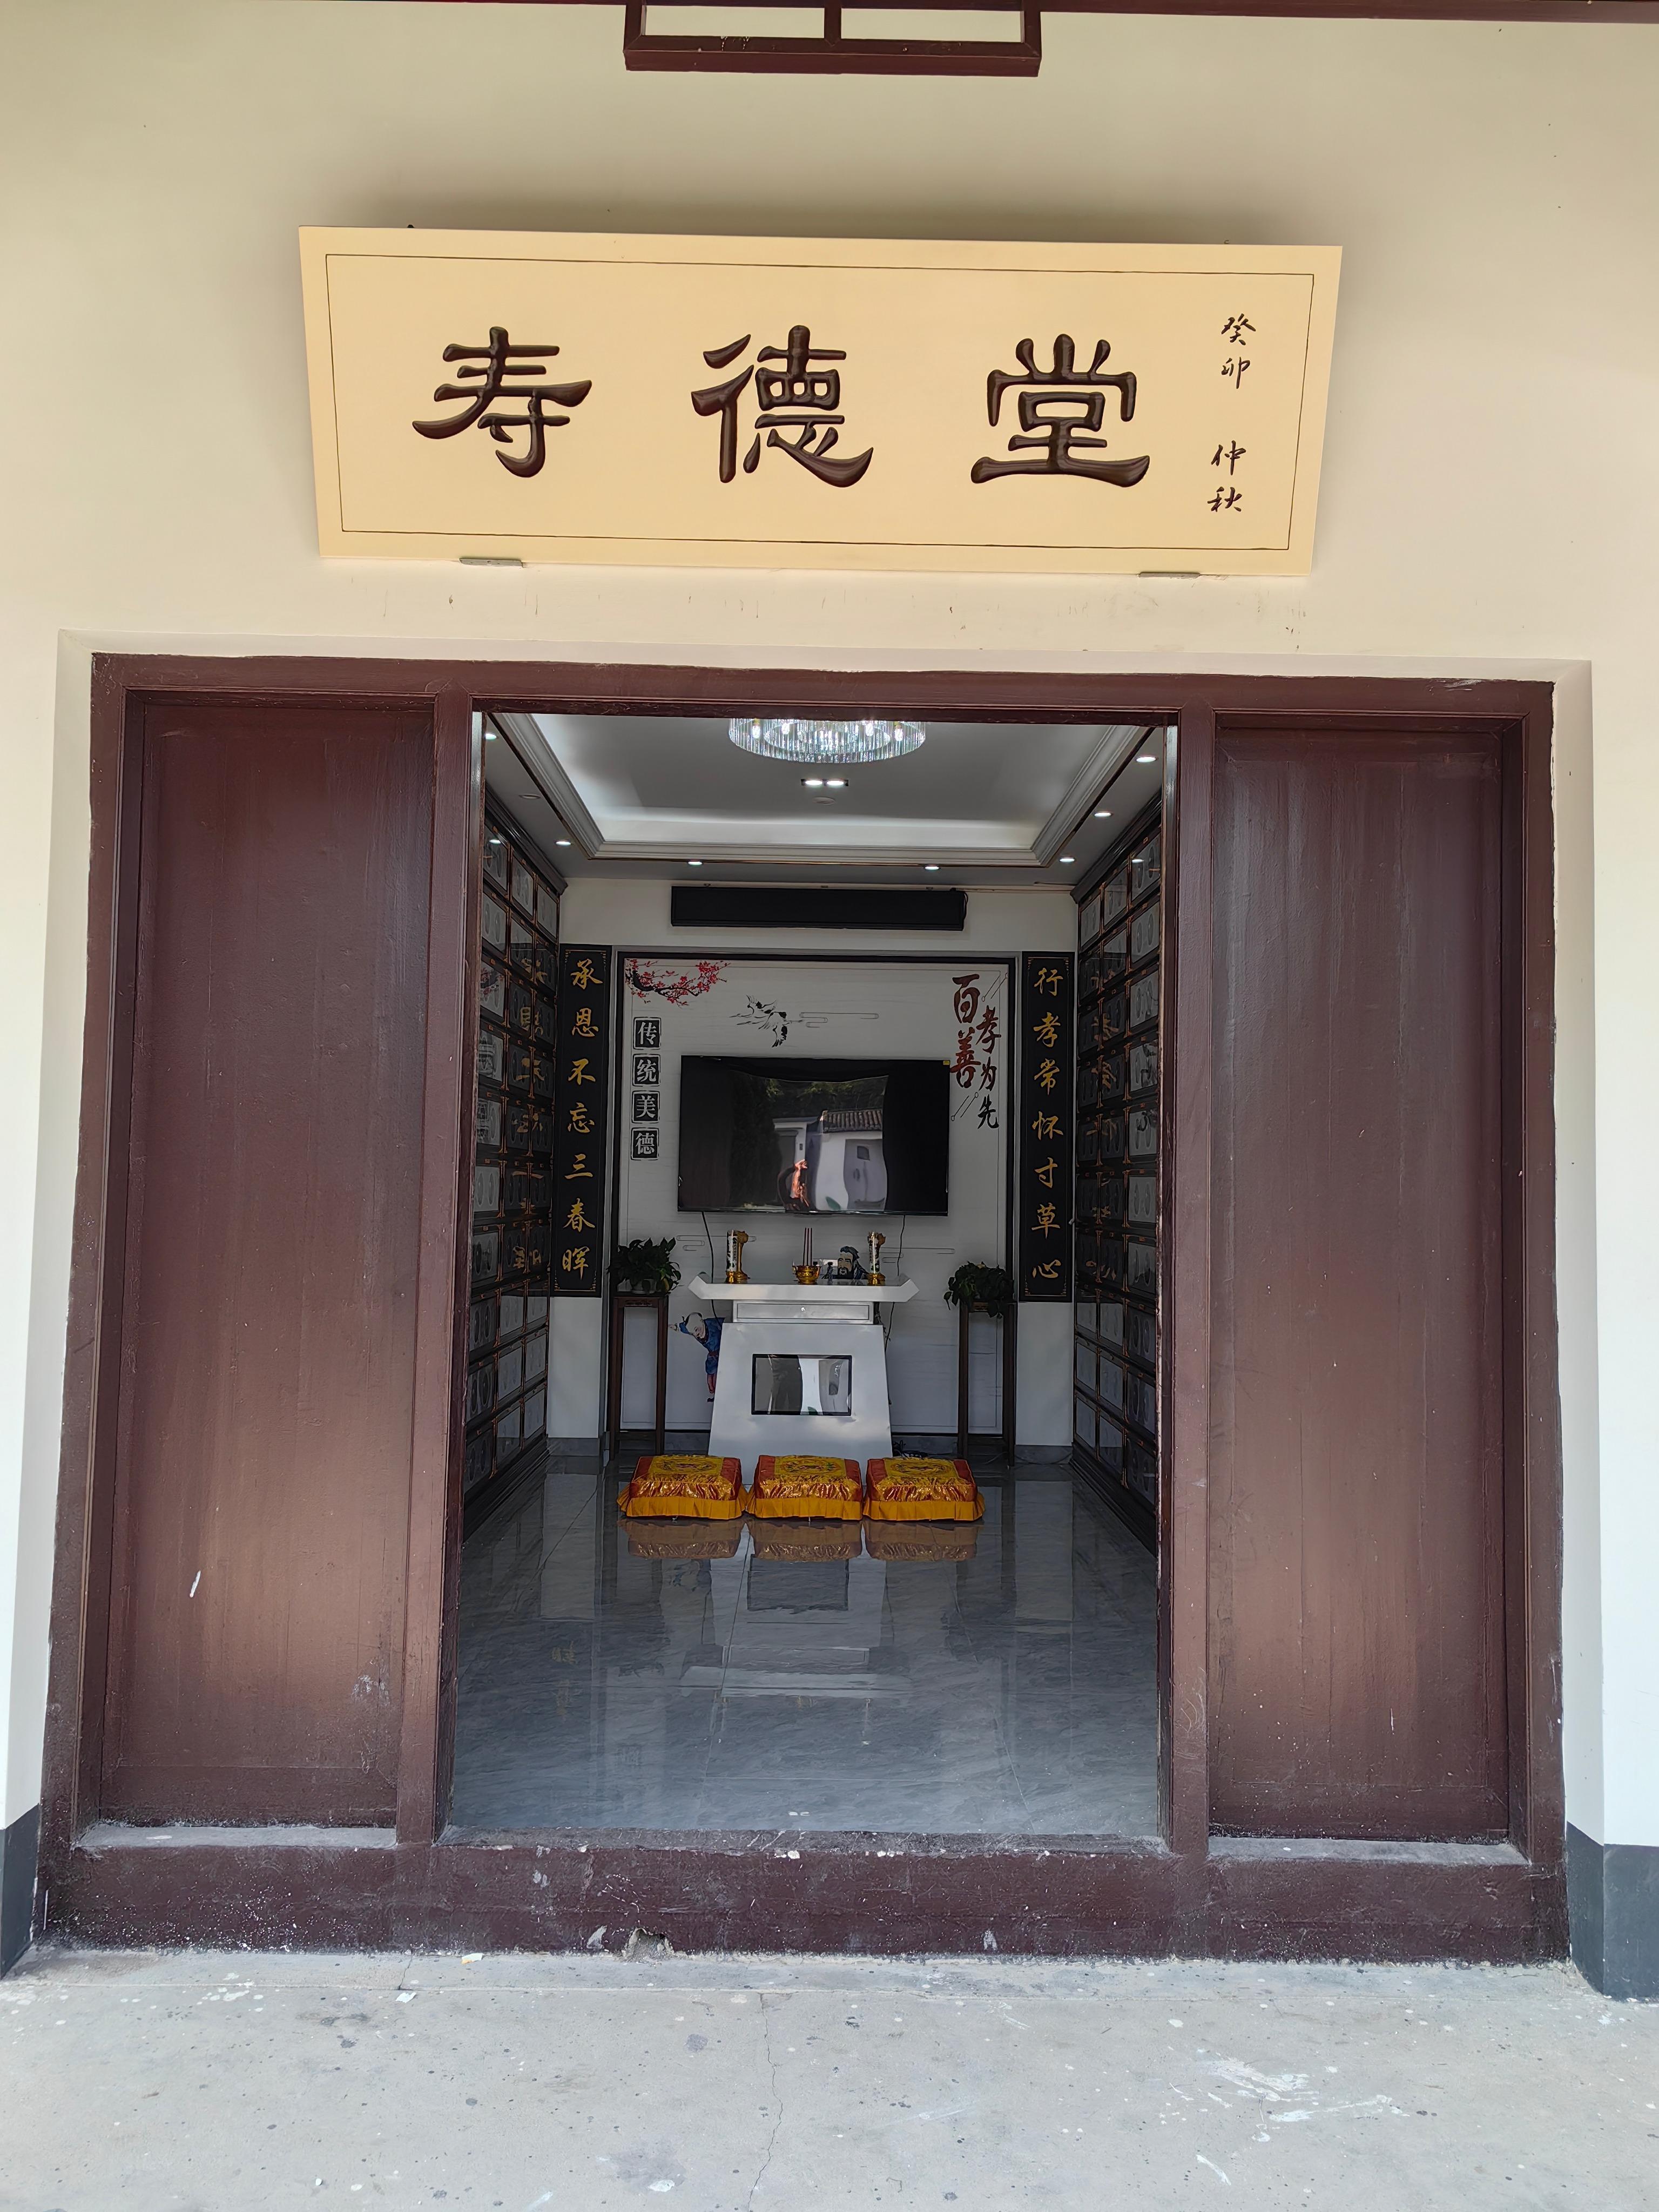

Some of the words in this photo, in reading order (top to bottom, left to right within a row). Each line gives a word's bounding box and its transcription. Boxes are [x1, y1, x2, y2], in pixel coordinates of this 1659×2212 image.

[412, 324, 1150, 488] 寿德堂
[1220, 313, 1256, 389] 癸卯
[1207, 440, 1246, 512] 仲秋
[633, 1020, 659, 1157] 传统美德
[949, 973, 981, 1089] 百善
[975, 1004, 1002, 1129] 孝为先
[562, 959, 604, 1280] 承恩不忘三春晖
[1030, 967, 1064, 1279] 行孝常怀寸草心
